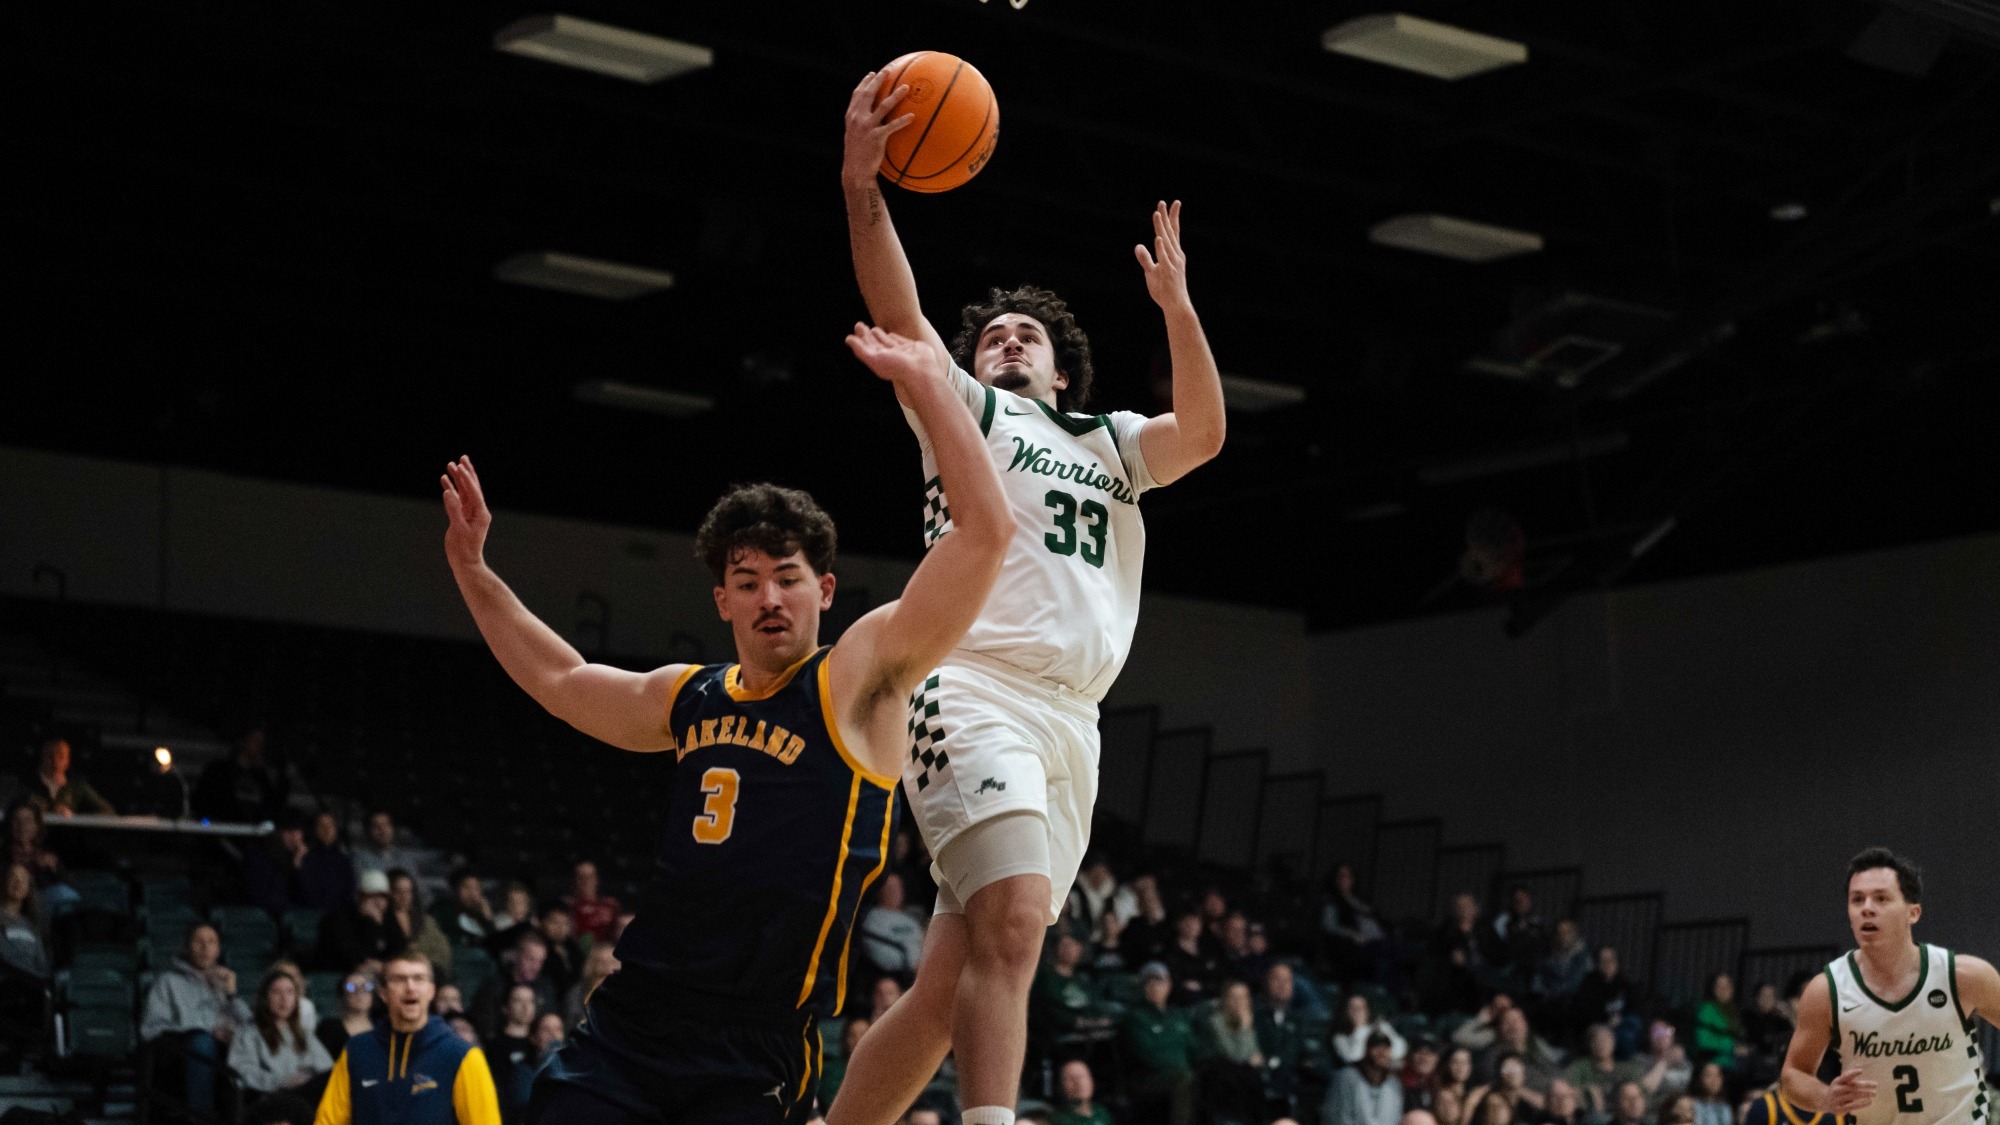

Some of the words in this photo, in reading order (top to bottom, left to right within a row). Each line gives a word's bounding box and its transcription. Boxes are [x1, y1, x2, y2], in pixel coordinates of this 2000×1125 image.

[1007, 436, 1134, 505] Warriors
[1044, 489, 1109, 569] 33
[675, 715, 805, 765] LAKELAND
[692, 767, 740, 845] 3
[1849, 1030, 1954, 1058] Warriors
[1892, 1065, 1923, 1113] 2
